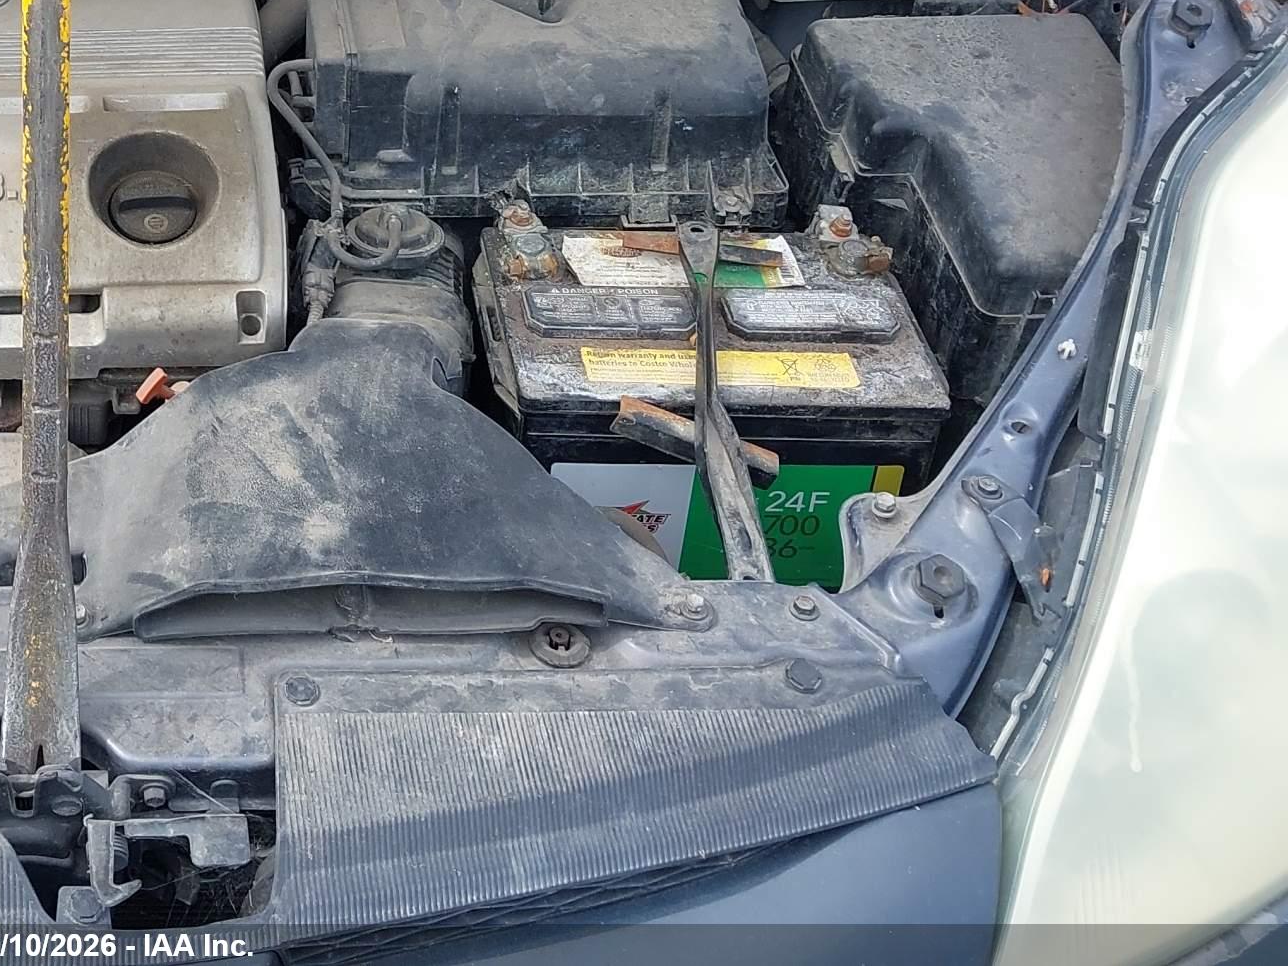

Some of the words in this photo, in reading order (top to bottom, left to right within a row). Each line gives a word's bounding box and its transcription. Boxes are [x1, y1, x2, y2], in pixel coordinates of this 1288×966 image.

[588, 358, 627, 367] batteries
[618, 351, 657, 360] warranty
[764, 490, 831, 513] 24F
[763, 514, 821, 536] 700
